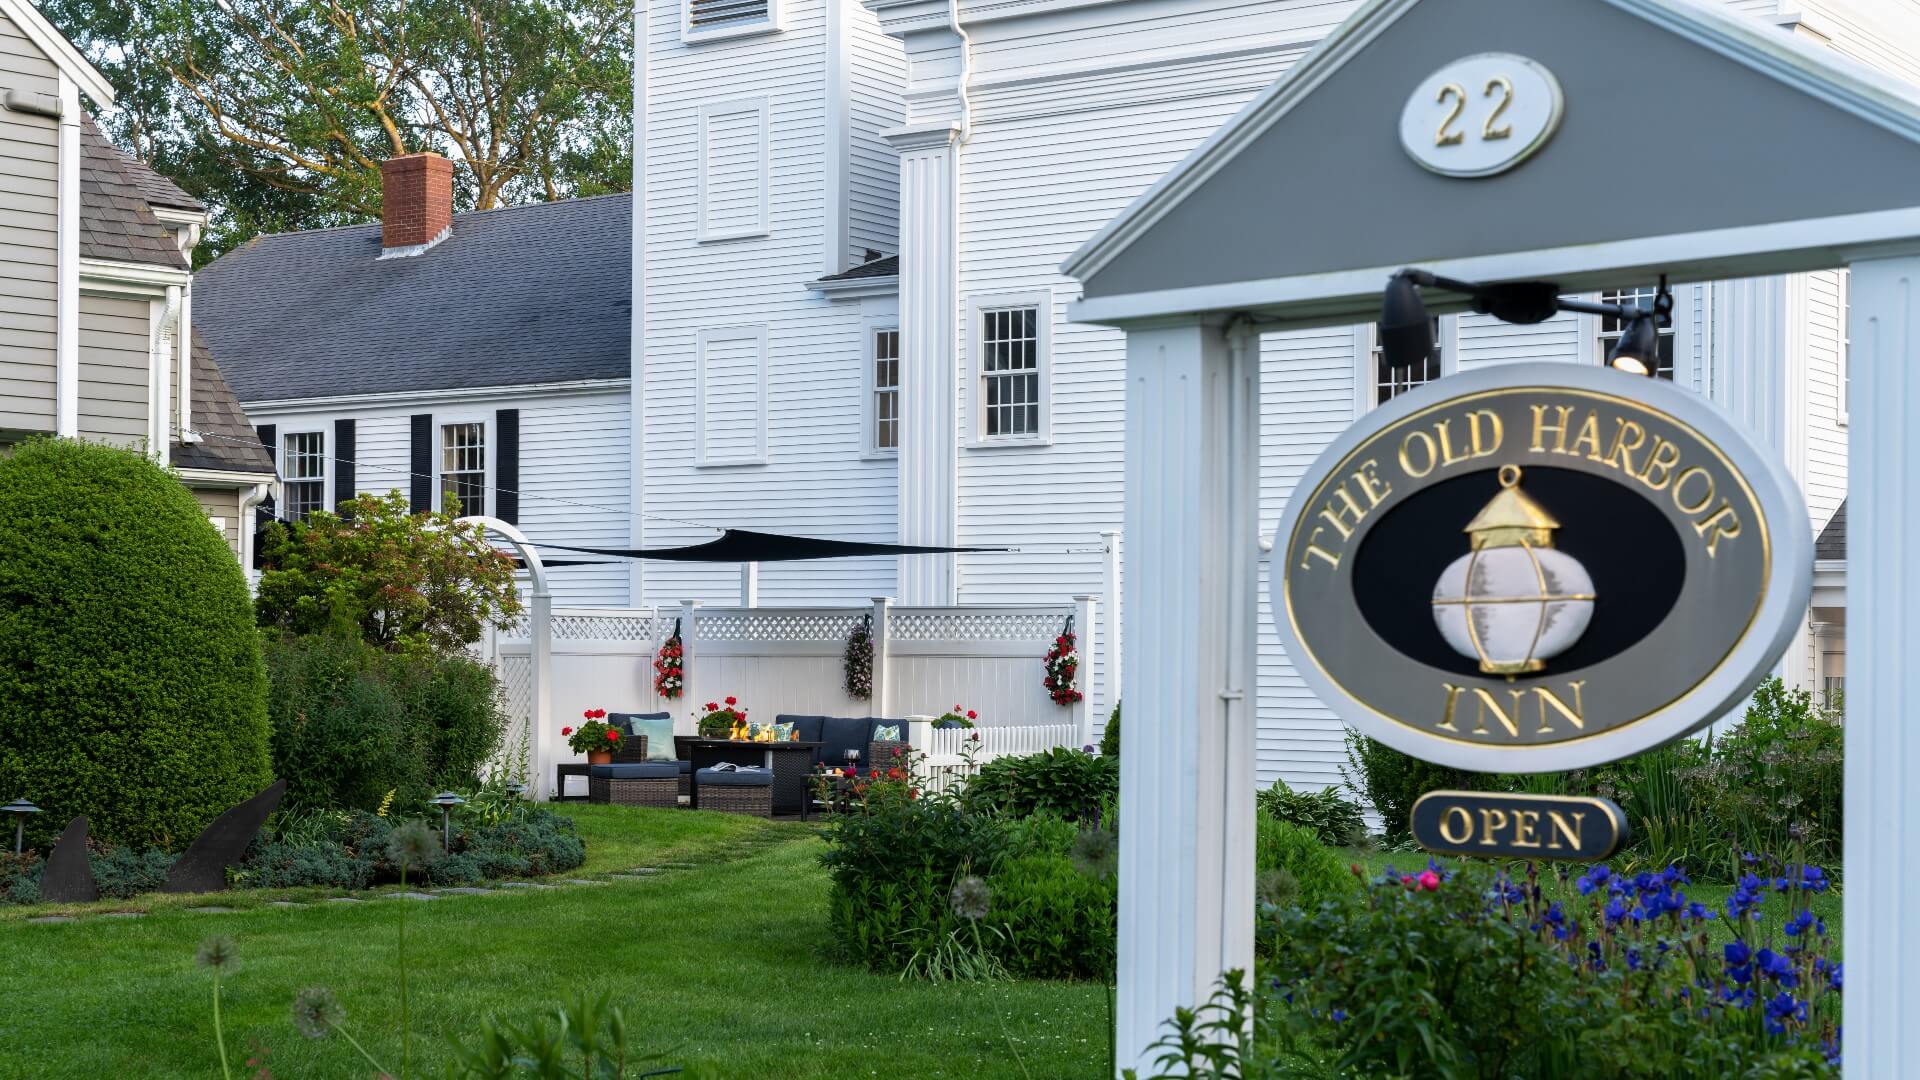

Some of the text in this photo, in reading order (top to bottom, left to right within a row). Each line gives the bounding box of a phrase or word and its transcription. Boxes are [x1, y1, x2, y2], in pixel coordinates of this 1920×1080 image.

[1435, 76, 1512, 147] 22
[1301, 404, 1742, 571] THE OLD HARBOR
[1436, 680, 1587, 737] INN
[1439, 806, 1585, 851] OPEN
